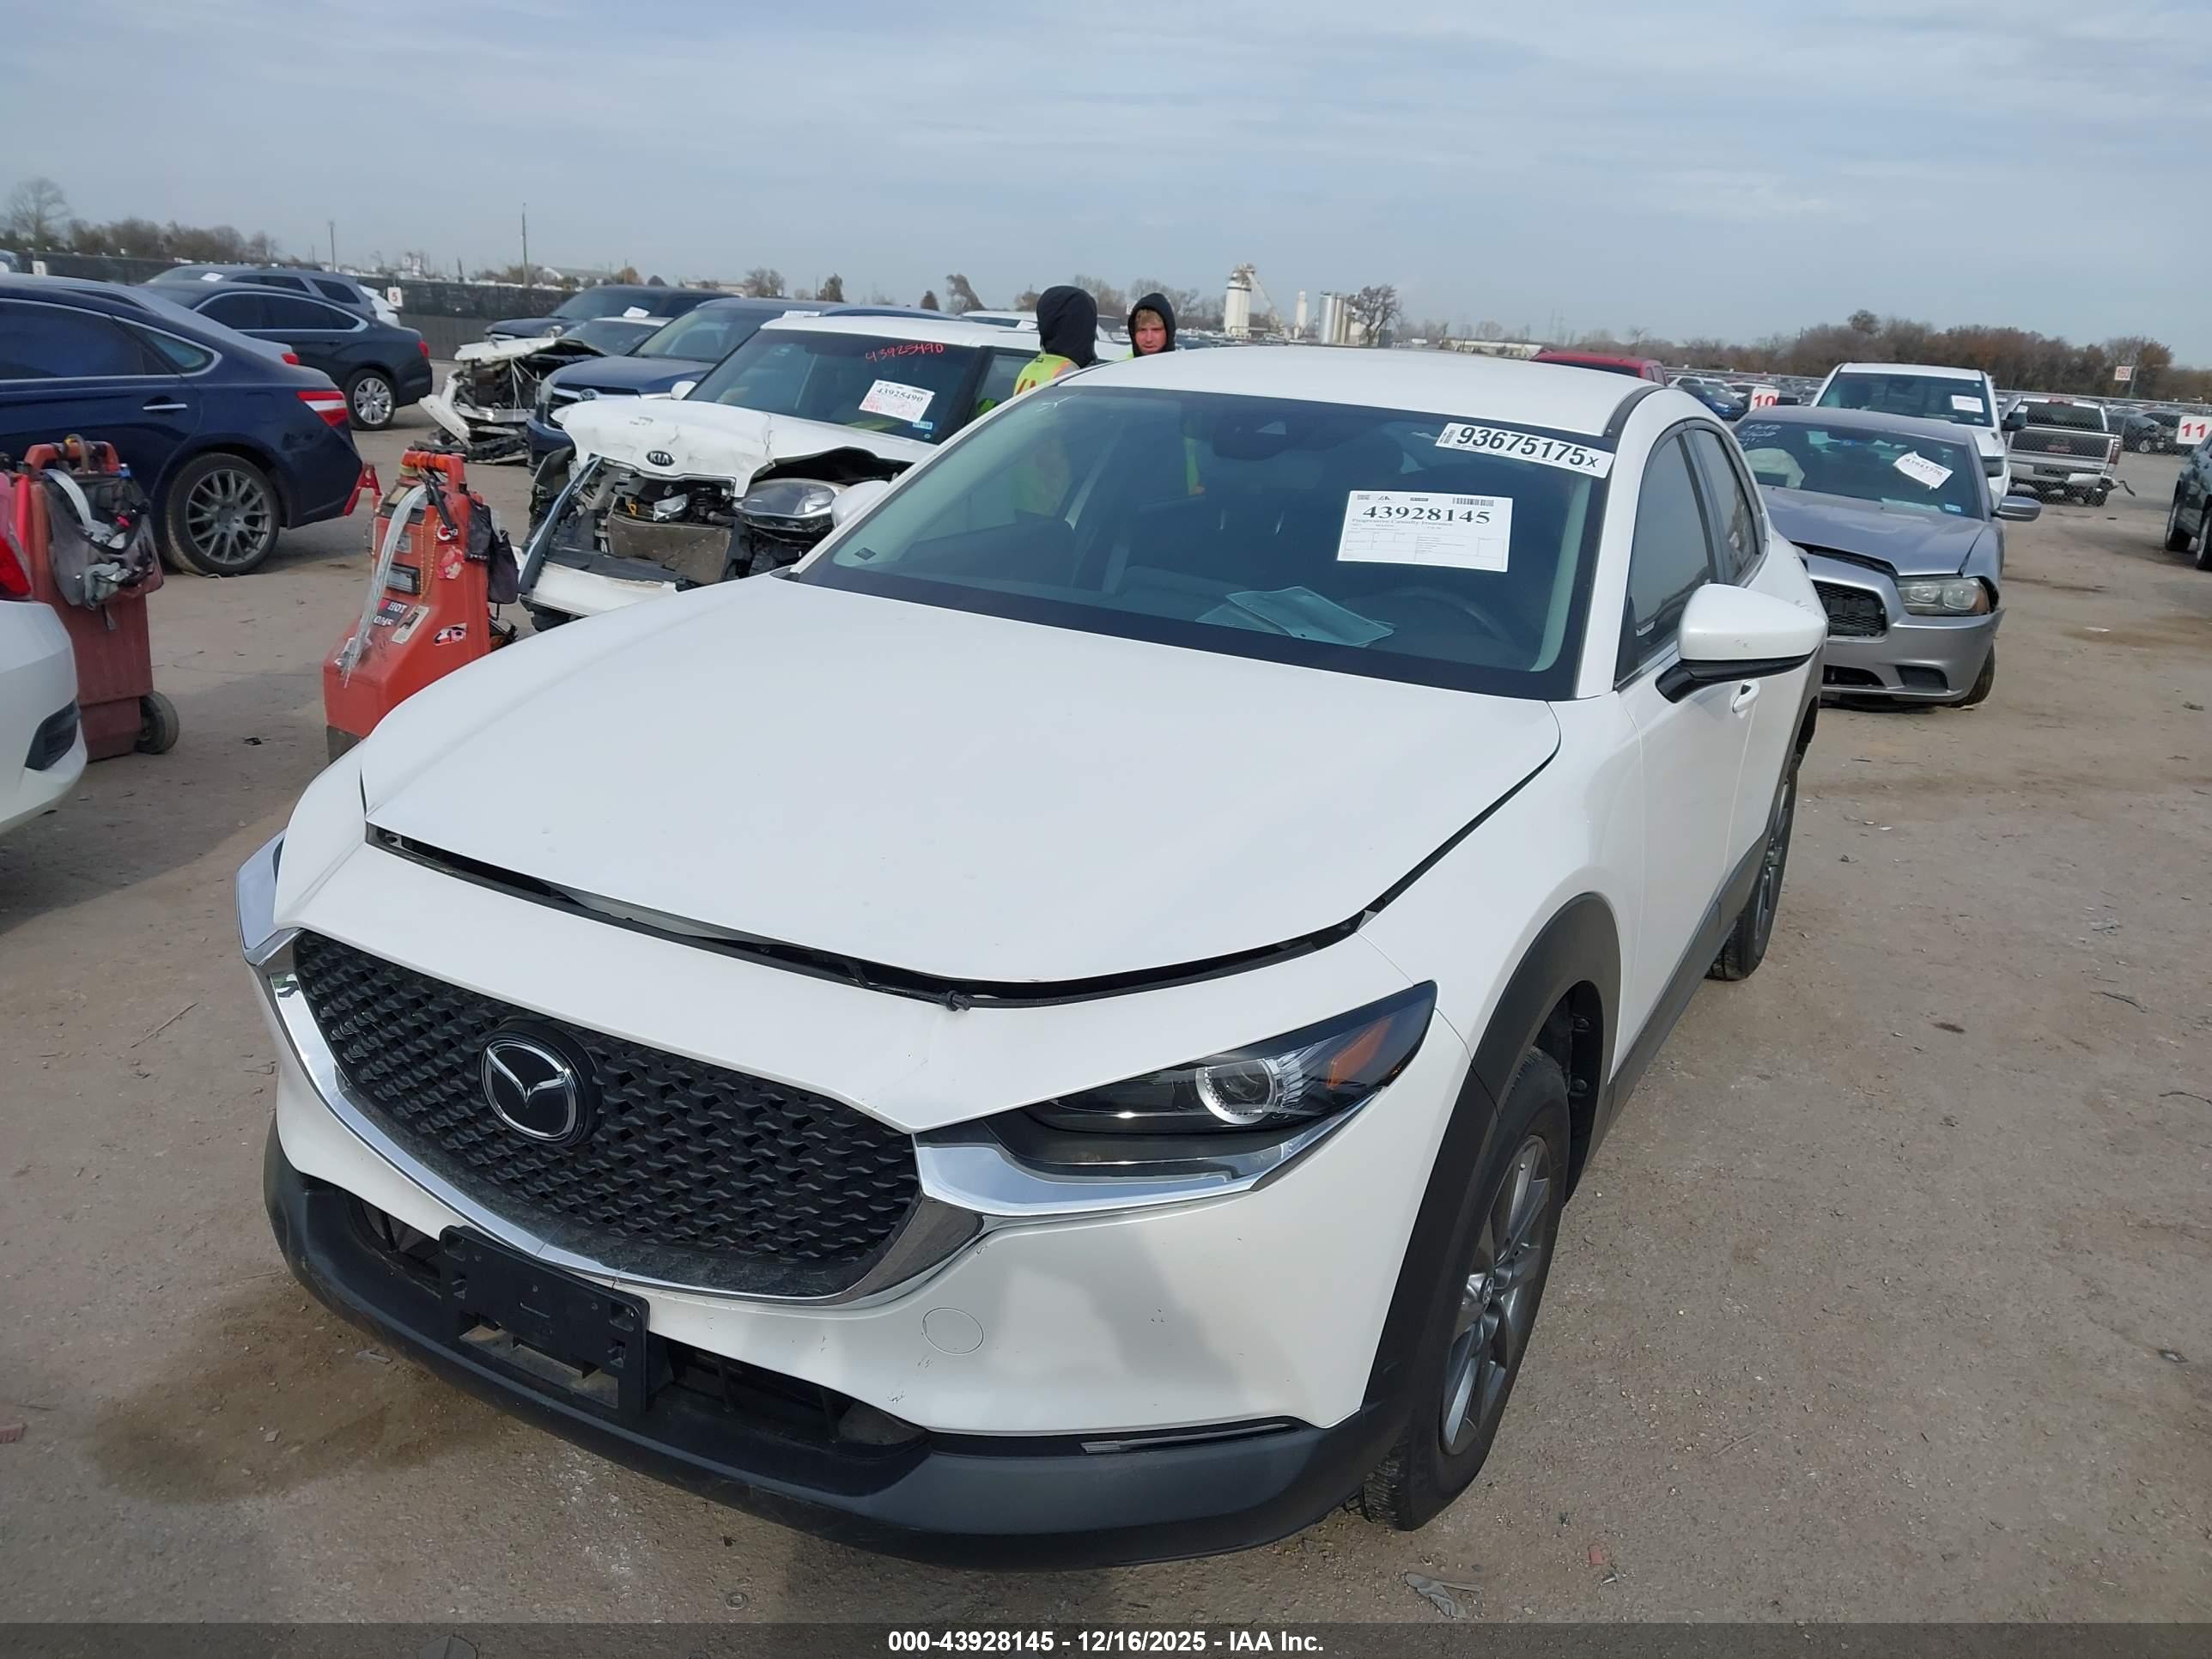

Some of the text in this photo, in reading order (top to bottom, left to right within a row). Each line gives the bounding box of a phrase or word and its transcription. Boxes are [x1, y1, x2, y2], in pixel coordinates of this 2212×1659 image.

[392, 292, 398, 302] 5
[876, 387, 924, 403] 43925490
[1753, 394, 1776, 407] 10
[2182, 422, 2206, 438] 11
[649, 452, 671, 465] KIA
[1363, 506, 1492, 525] 43928145
[387, 601, 408, 613] HOT
